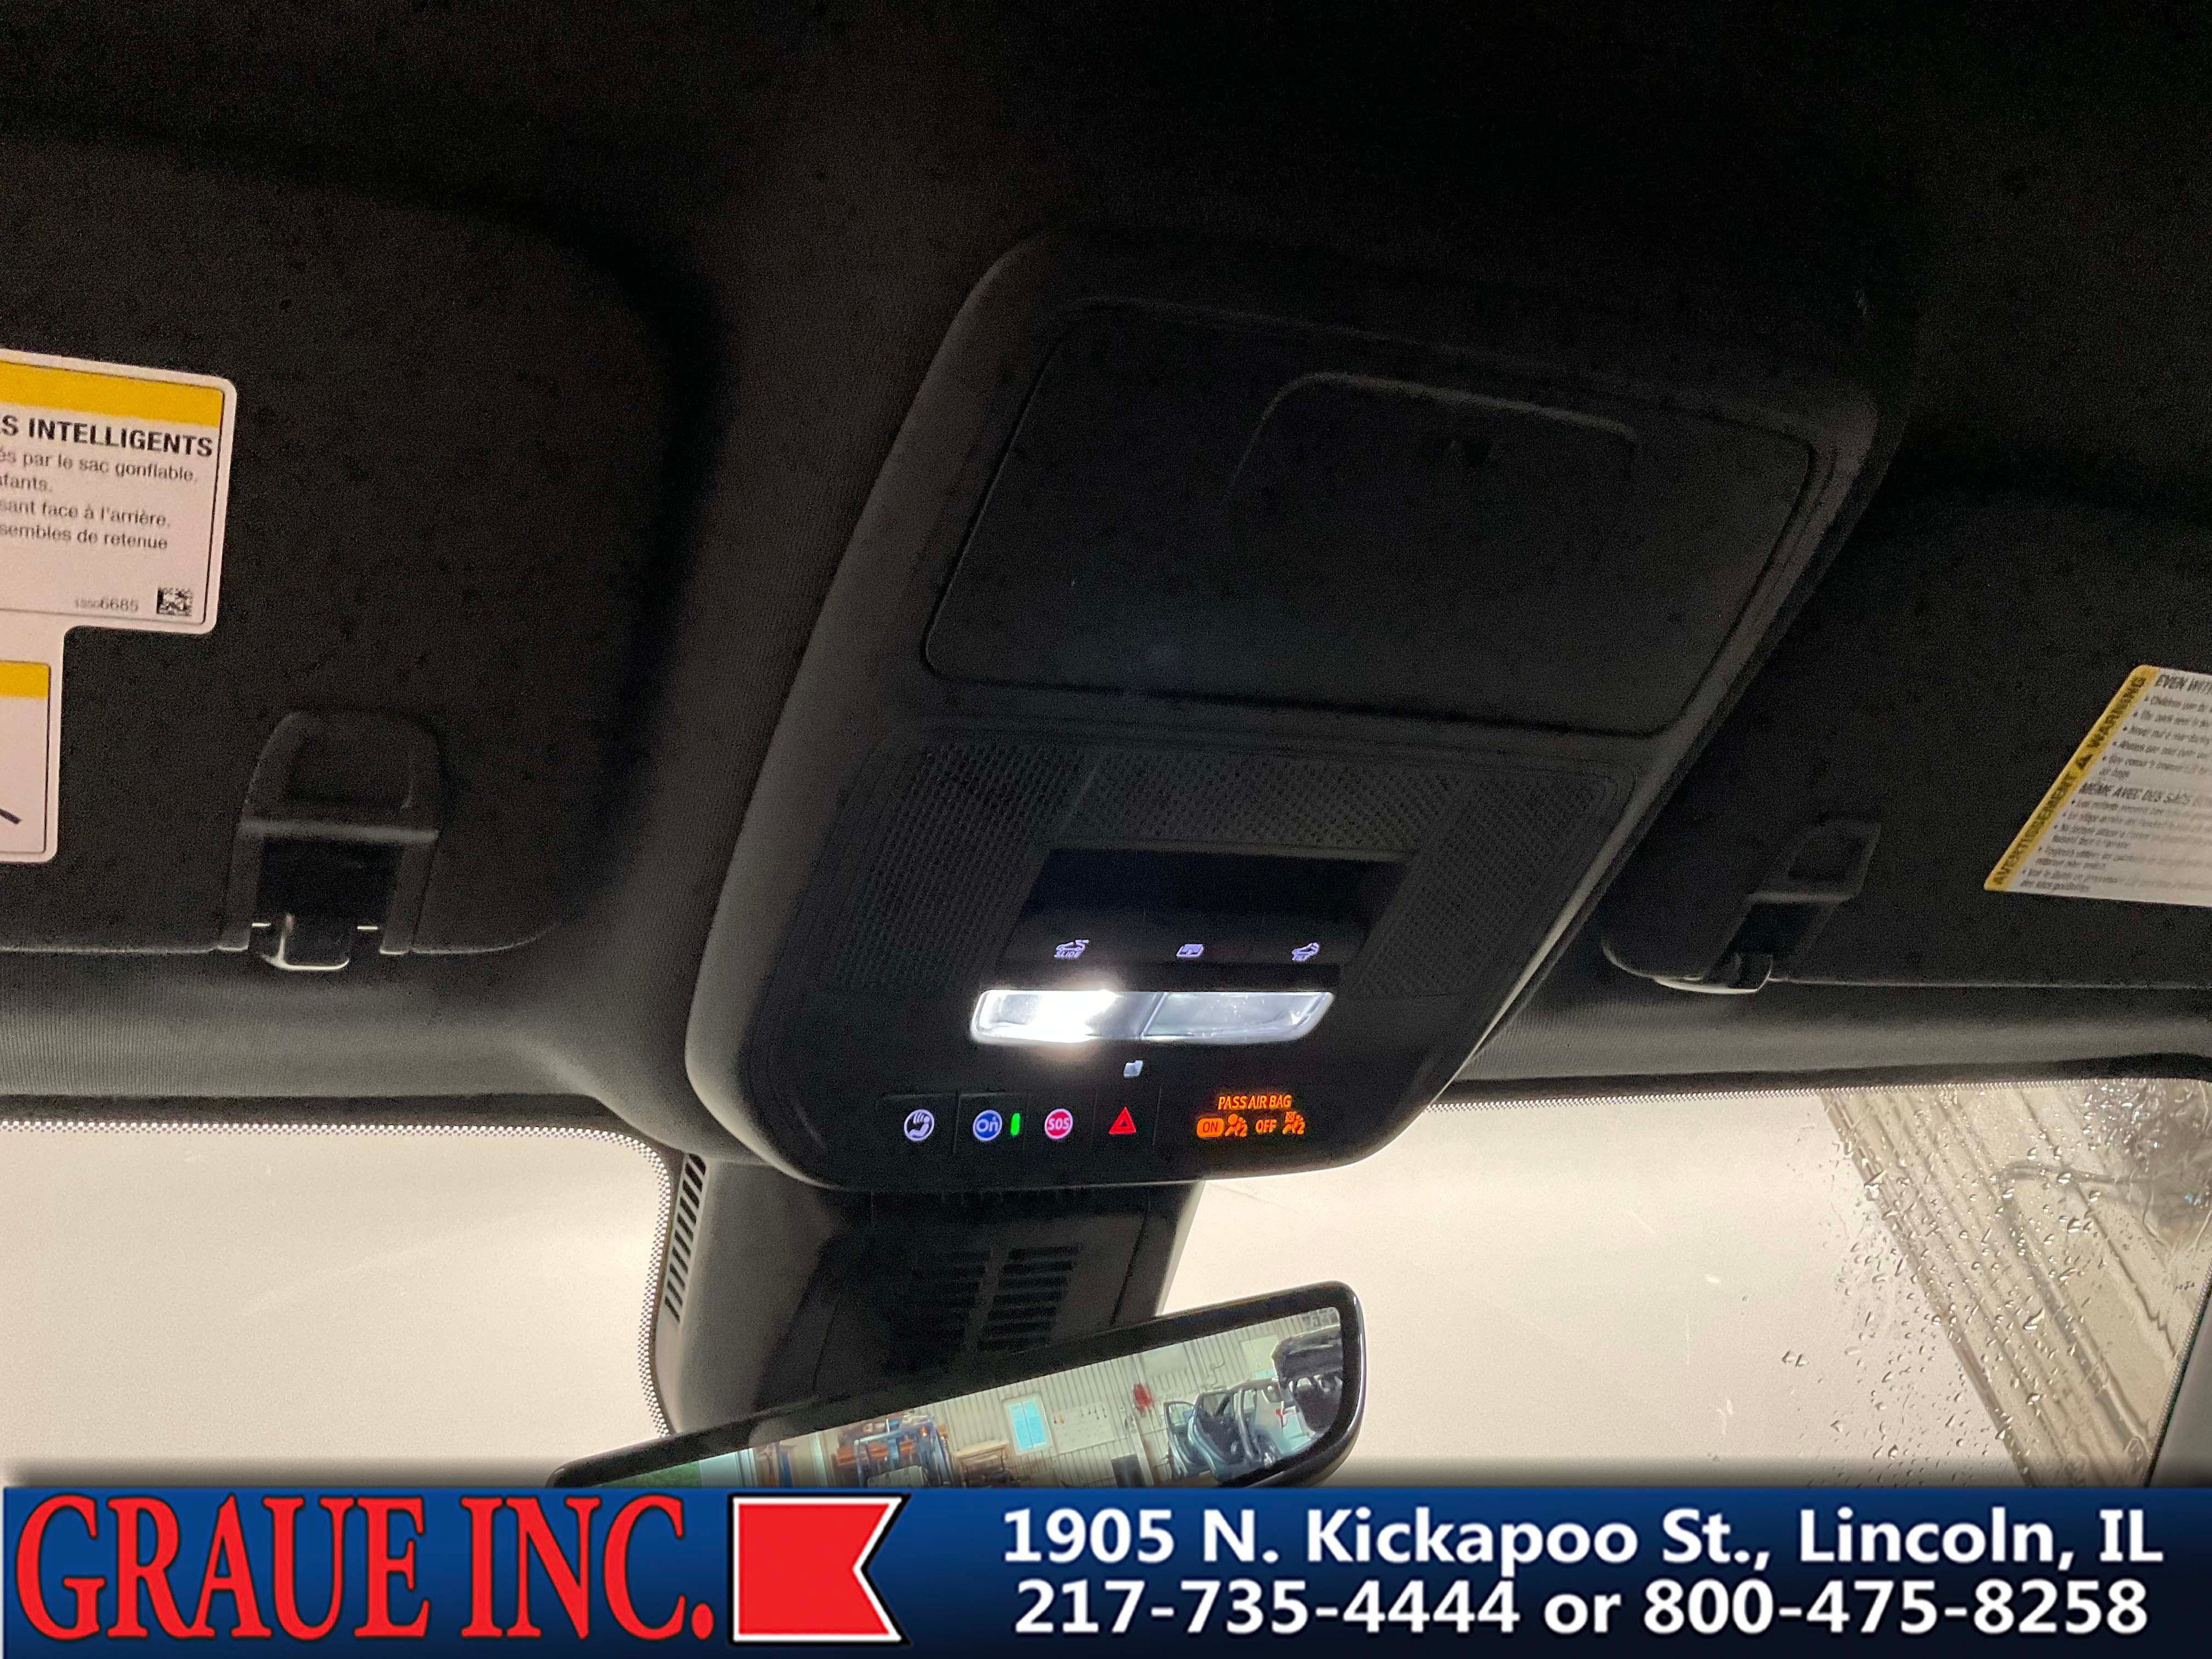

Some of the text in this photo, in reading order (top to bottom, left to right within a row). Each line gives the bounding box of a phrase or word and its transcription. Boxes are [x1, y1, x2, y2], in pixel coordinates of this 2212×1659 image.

[29, 417, 212, 457] INTELLIGENTS
[24, 453, 53, 468] par
[58, 453, 73, 470] le
[79, 458, 110, 474] sac
[116, 462, 197, 483] gonflable.
[42, 500, 78, 520] face
[84, 504, 94, 520] à
[101, 505, 170, 529] l'arrière.
[77, 528, 98, 544] de
[104, 532, 167, 549] retenue
[1217, 1094, 1291, 1110] PASS AIR BAG
[1048, 1118, 1070, 1130] SOS
[1203, 1121, 1218, 1133] ON
[1255, 1119, 1277, 1133] OFF
